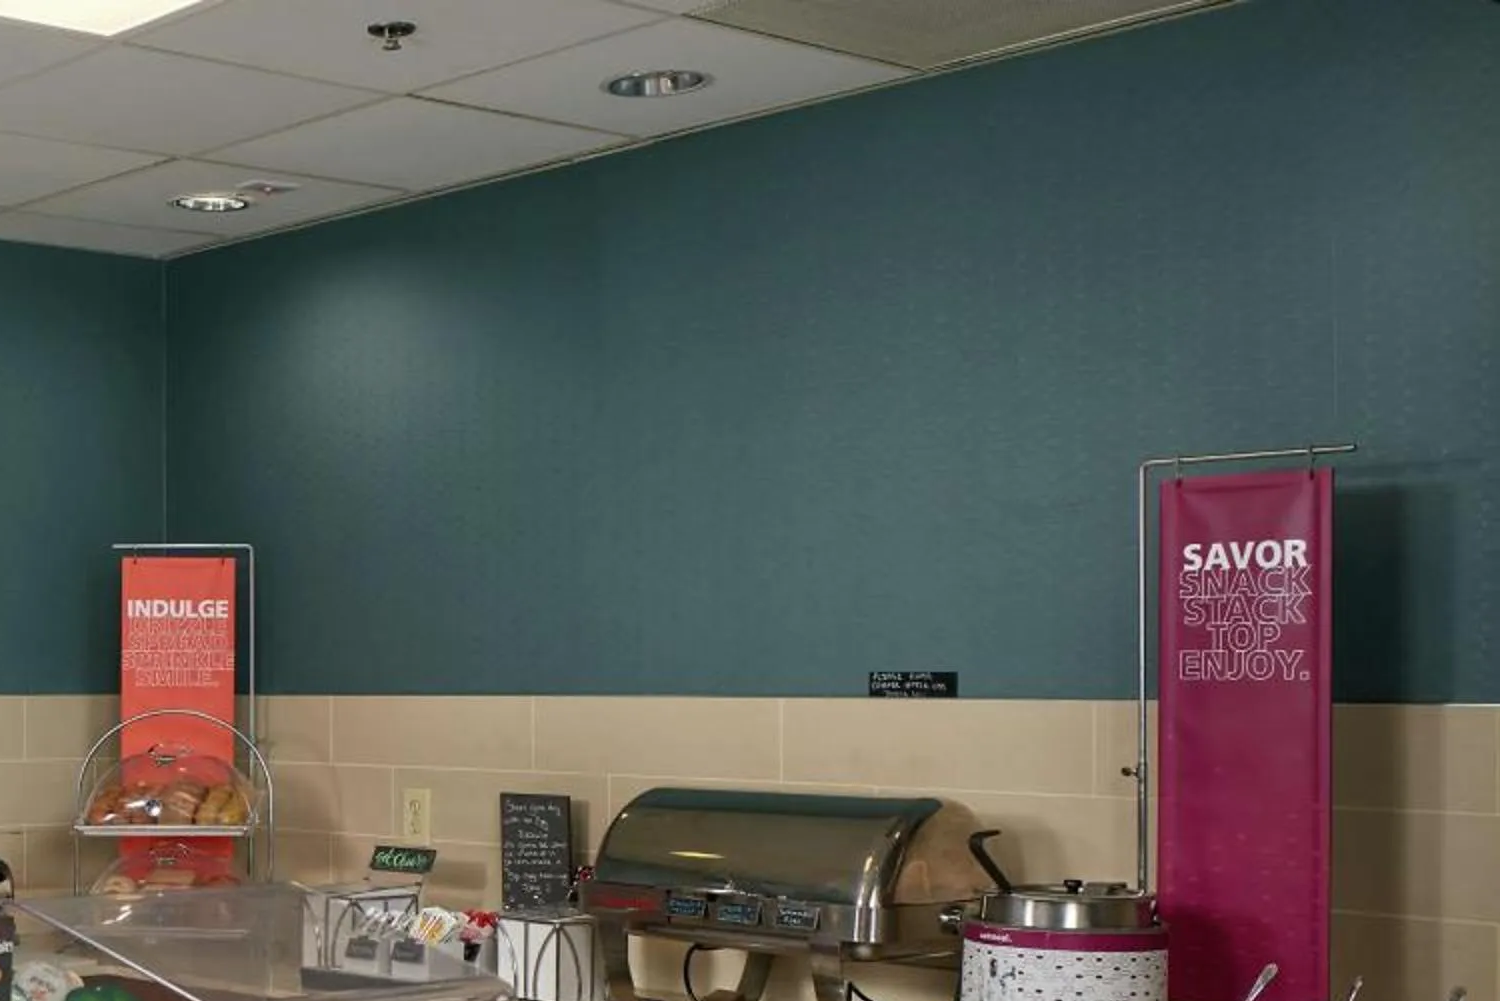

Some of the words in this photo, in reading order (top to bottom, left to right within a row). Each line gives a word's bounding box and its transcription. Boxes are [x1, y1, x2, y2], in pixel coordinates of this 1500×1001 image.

[1183, 540, 1308, 571] SAVOR
[1179, 565, 1313, 599] SNACK
[127, 599, 229, 618] INDULGE
[1183, 594, 1306, 625] STACK
[1206, 621, 1281, 652] TOP
[1179, 649, 1311, 681] ENJOY.
